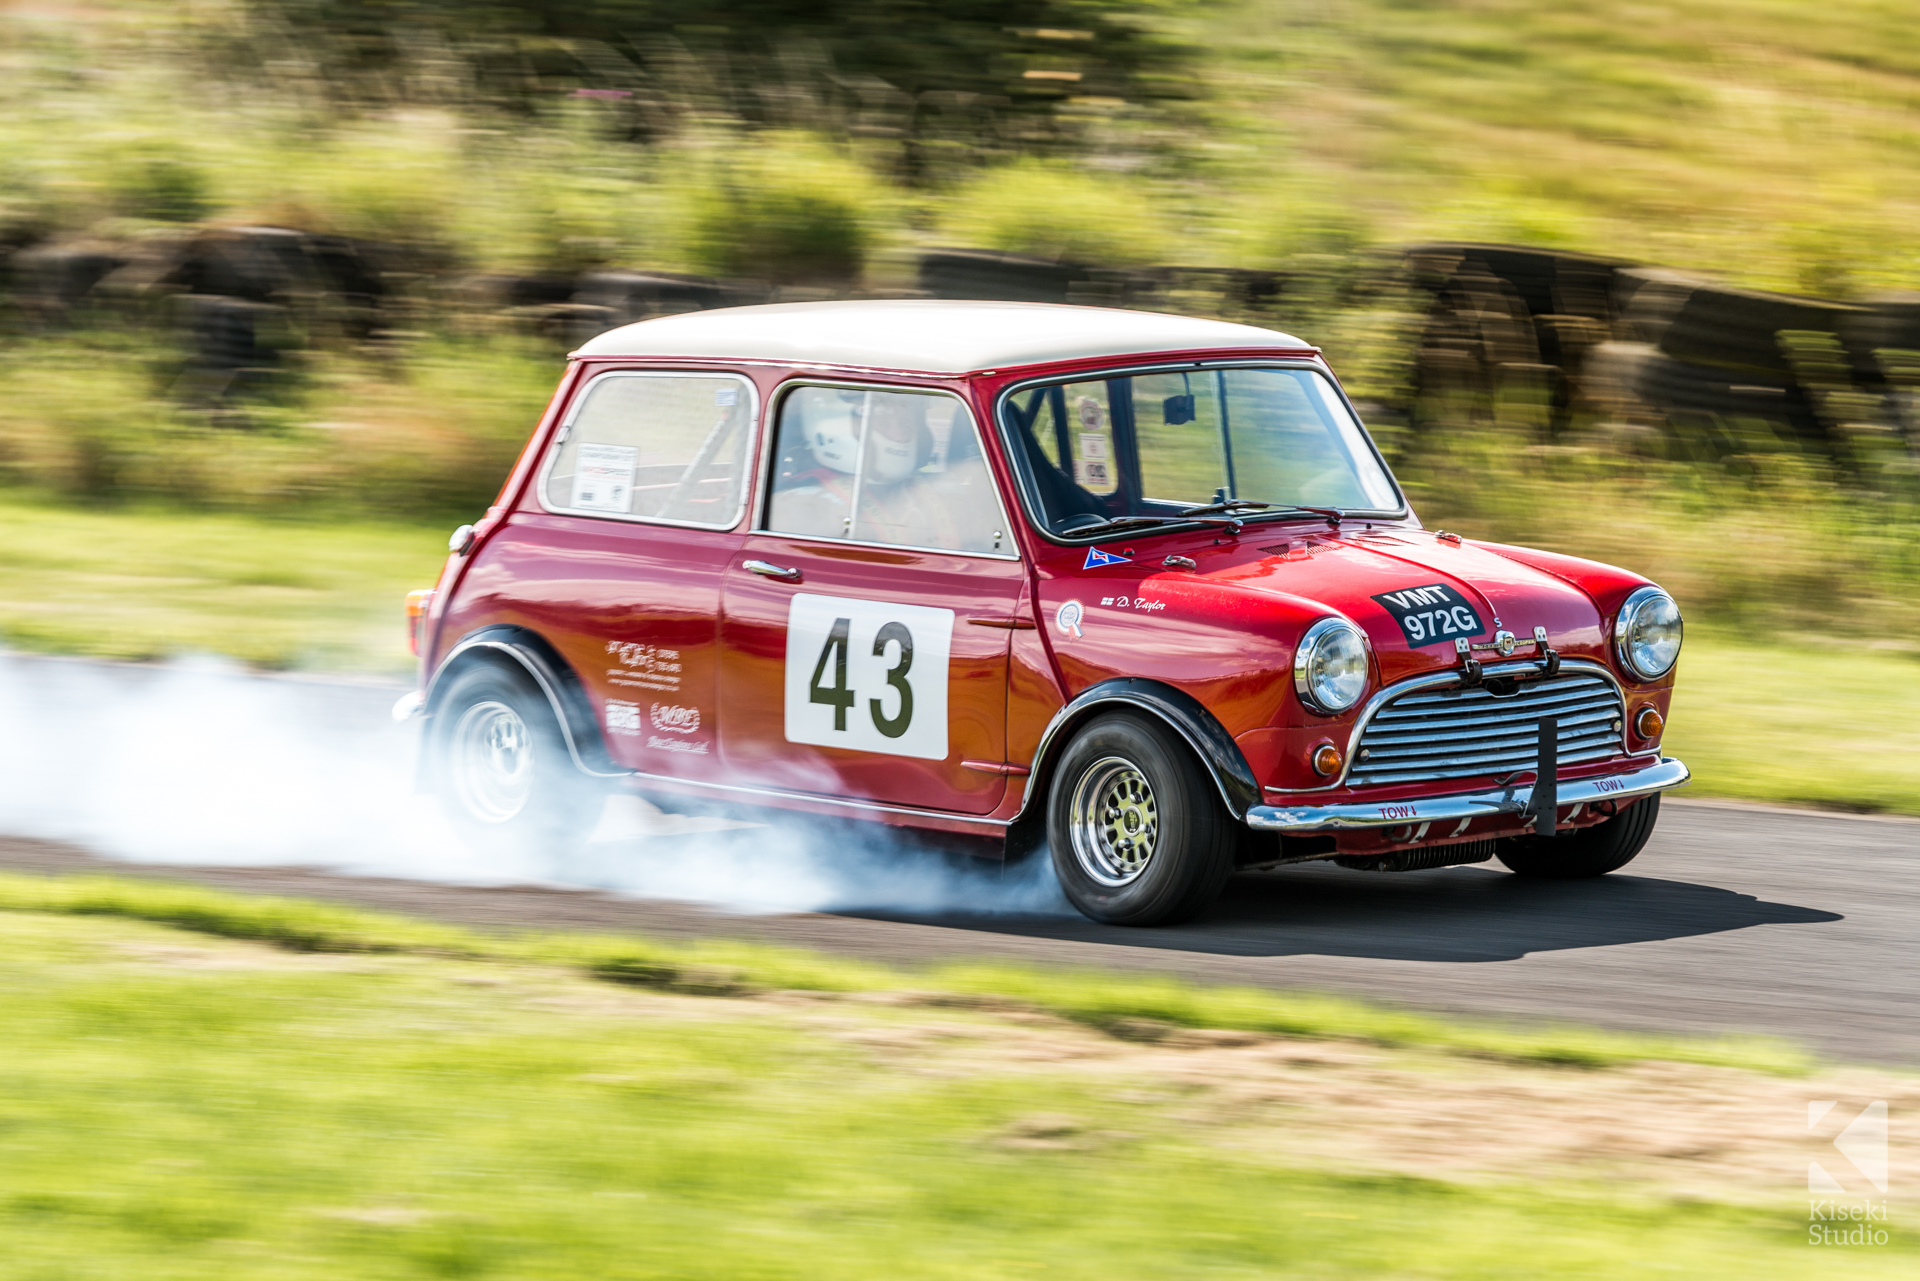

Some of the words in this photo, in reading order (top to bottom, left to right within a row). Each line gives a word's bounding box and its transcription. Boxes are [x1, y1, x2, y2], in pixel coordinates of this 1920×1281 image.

[1116, 596, 1130, 607] D.
[1134, 597, 1166, 612] Taylor
[1383, 586, 1450, 609] VMT
[1404, 606, 1477, 640] 972G
[1494, 617, 1502, 627] S
[809, 617, 913, 738] 43
[1593, 781, 1619, 793] TOW
[1378, 806, 1409, 819] TOW
